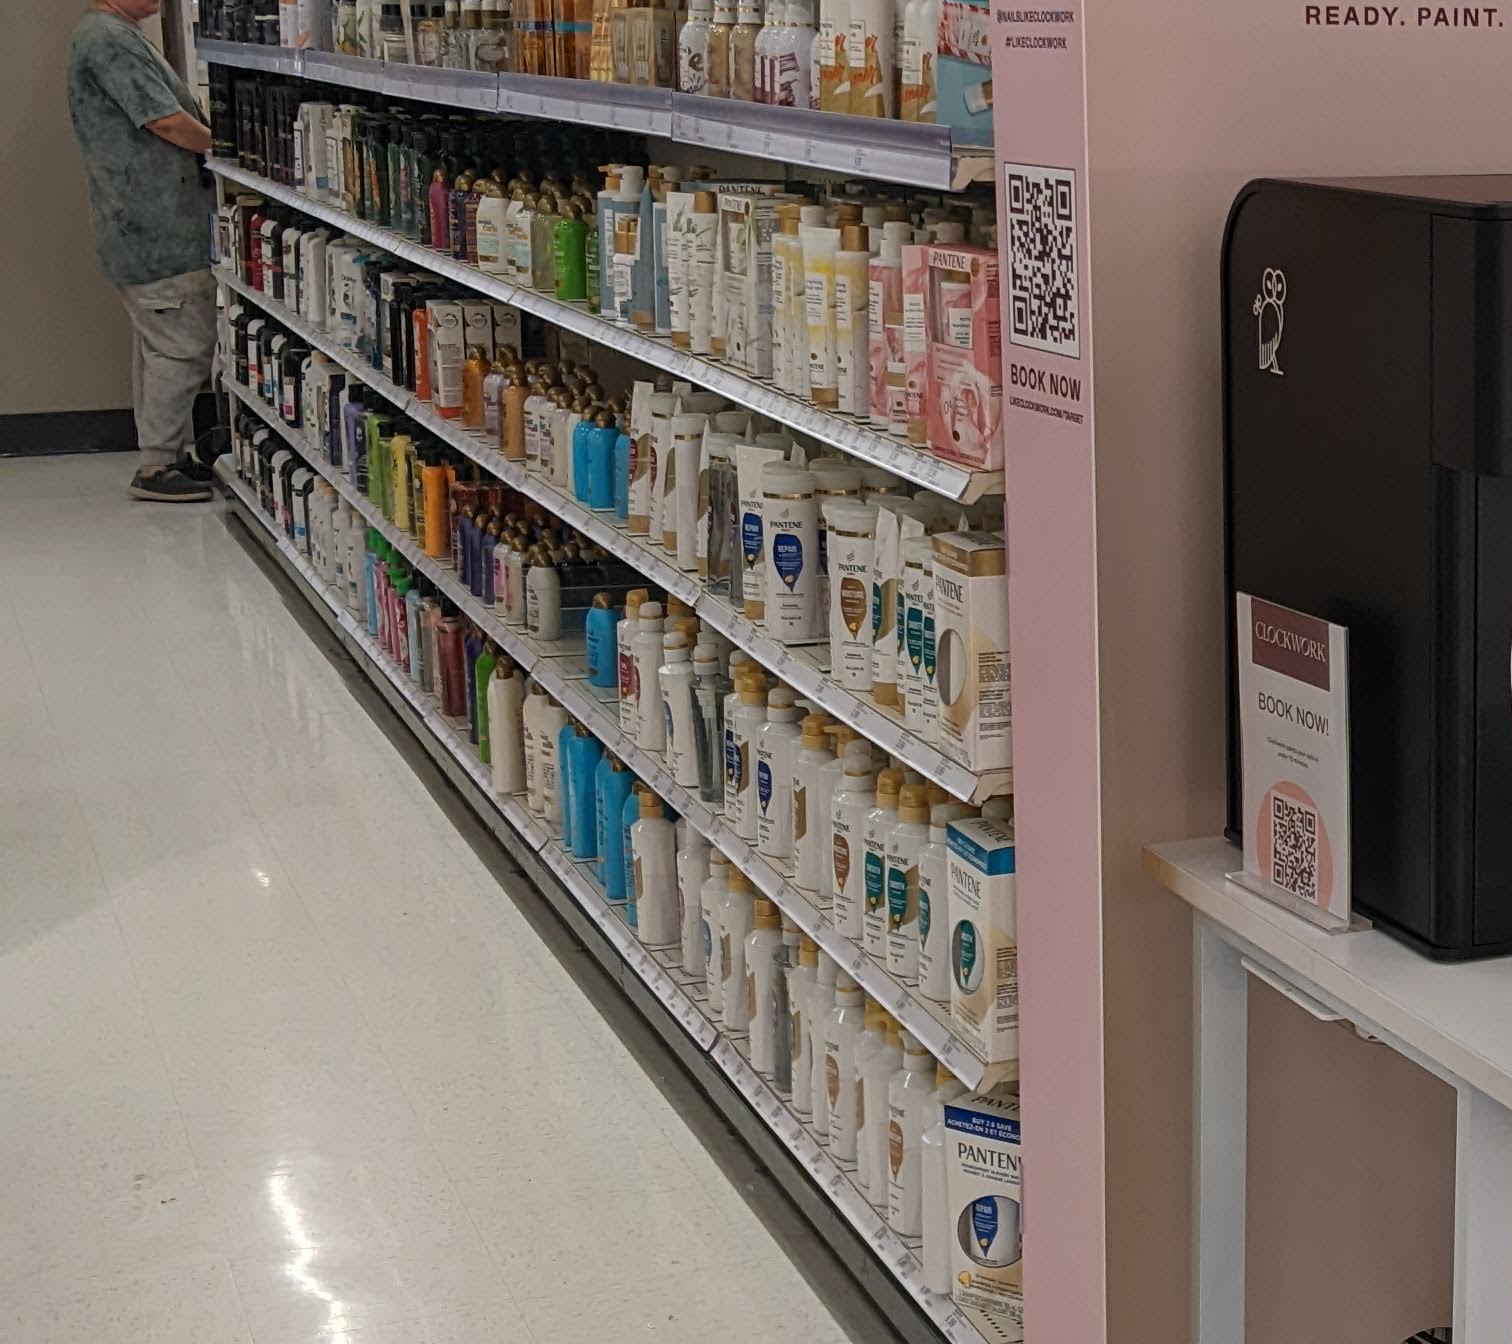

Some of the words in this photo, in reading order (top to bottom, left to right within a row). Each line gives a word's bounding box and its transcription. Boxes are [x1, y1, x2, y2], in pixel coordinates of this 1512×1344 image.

[1305, 6, 1405, 27] READY.
[1417, 7, 1504, 28] PAINT.
[1005, 36, 1068, 49] #LIKECLOCKWORK
[933, 251, 966, 270] PANTENE
[1010, 363, 1046, 393] BOOK
[1049, 373, 1081, 402] NOW
[769, 520, 803, 529] PANTENE
[838, 563, 868, 574] PANTENE
[935, 574, 963, 604] PANTENE
[1255, 621, 1326, 662] CLOCKWORK
[1258, 691, 1294, 723] BOOK
[1296, 706, 1330, 737] NOW!
[951, 862, 982, 900] PANTENE
[997, 1122, 1012, 1132] SAVE
